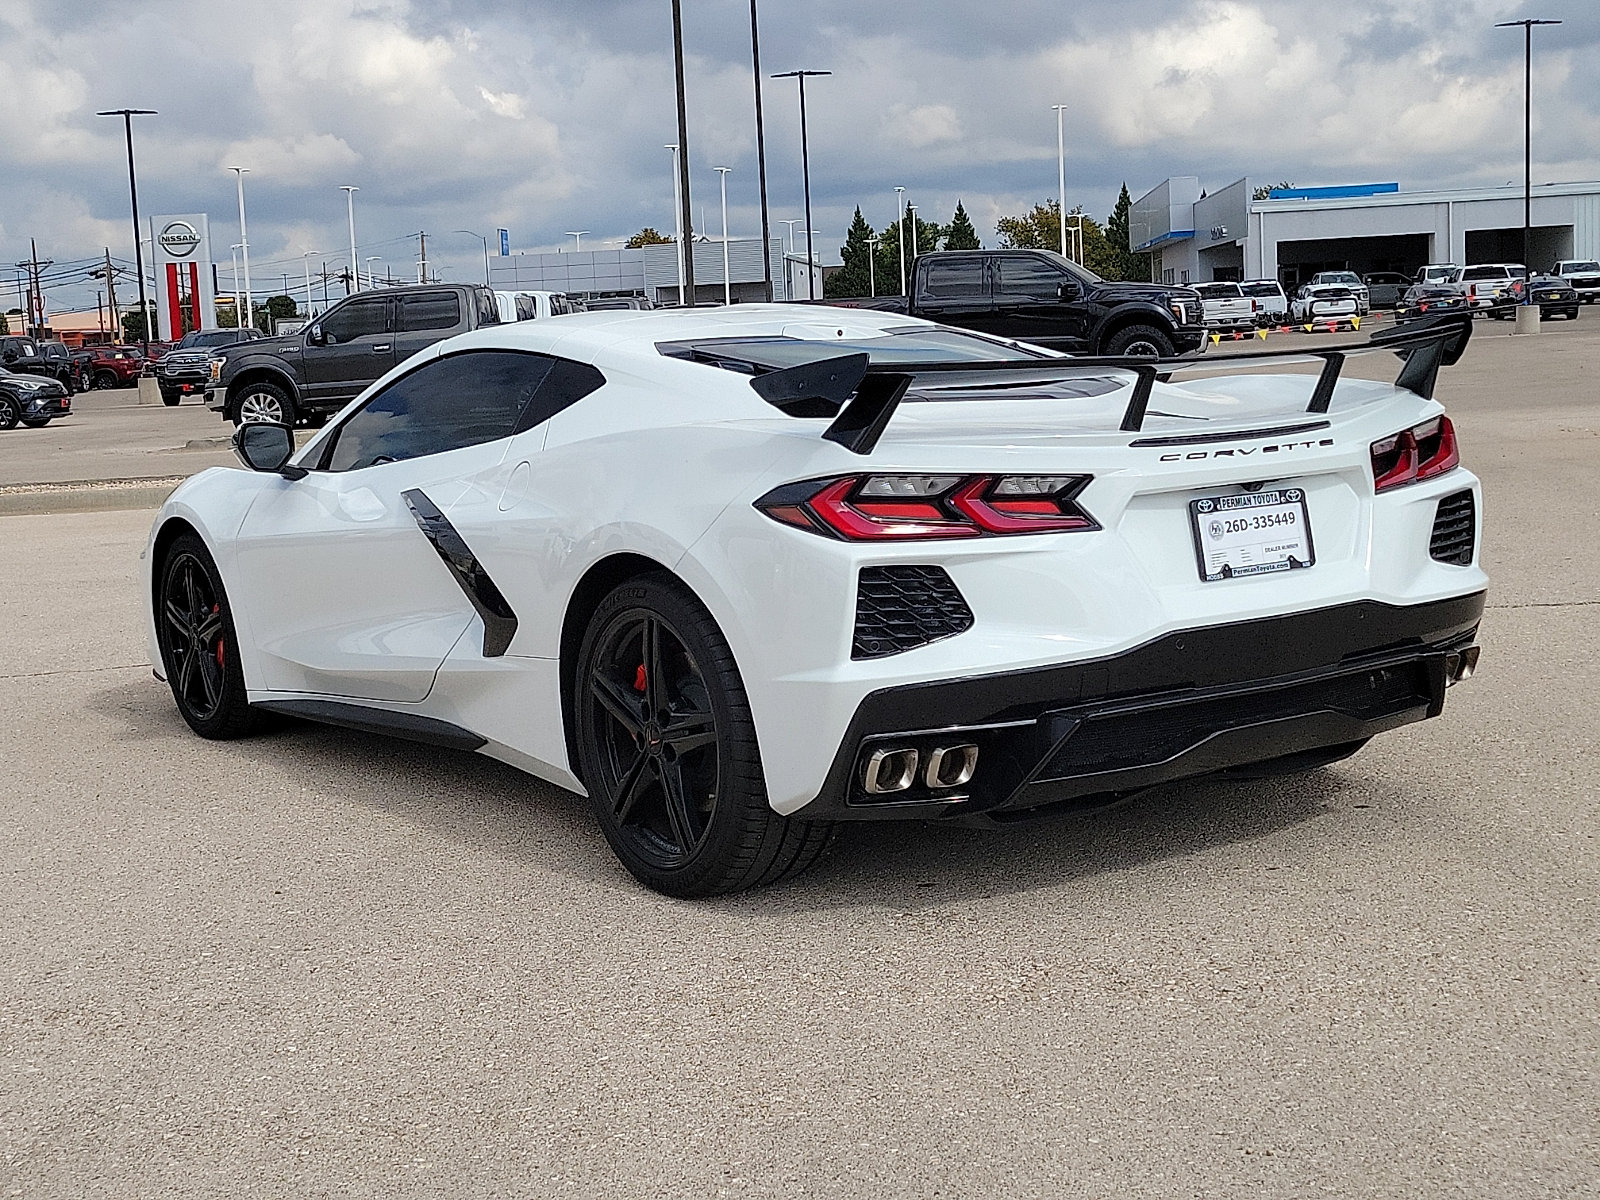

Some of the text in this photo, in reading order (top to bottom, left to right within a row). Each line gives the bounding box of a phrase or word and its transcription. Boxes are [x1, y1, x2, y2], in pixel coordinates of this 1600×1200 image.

[161, 234, 196, 243] NISSAN
[1159, 438, 1335, 462] CORVETTE
[1221, 493, 1279, 509] PERMIAN TOYOTA
[1224, 511, 1296, 534] 26D-335449
[1232, 562, 1289, 576] PermianToyota.com
